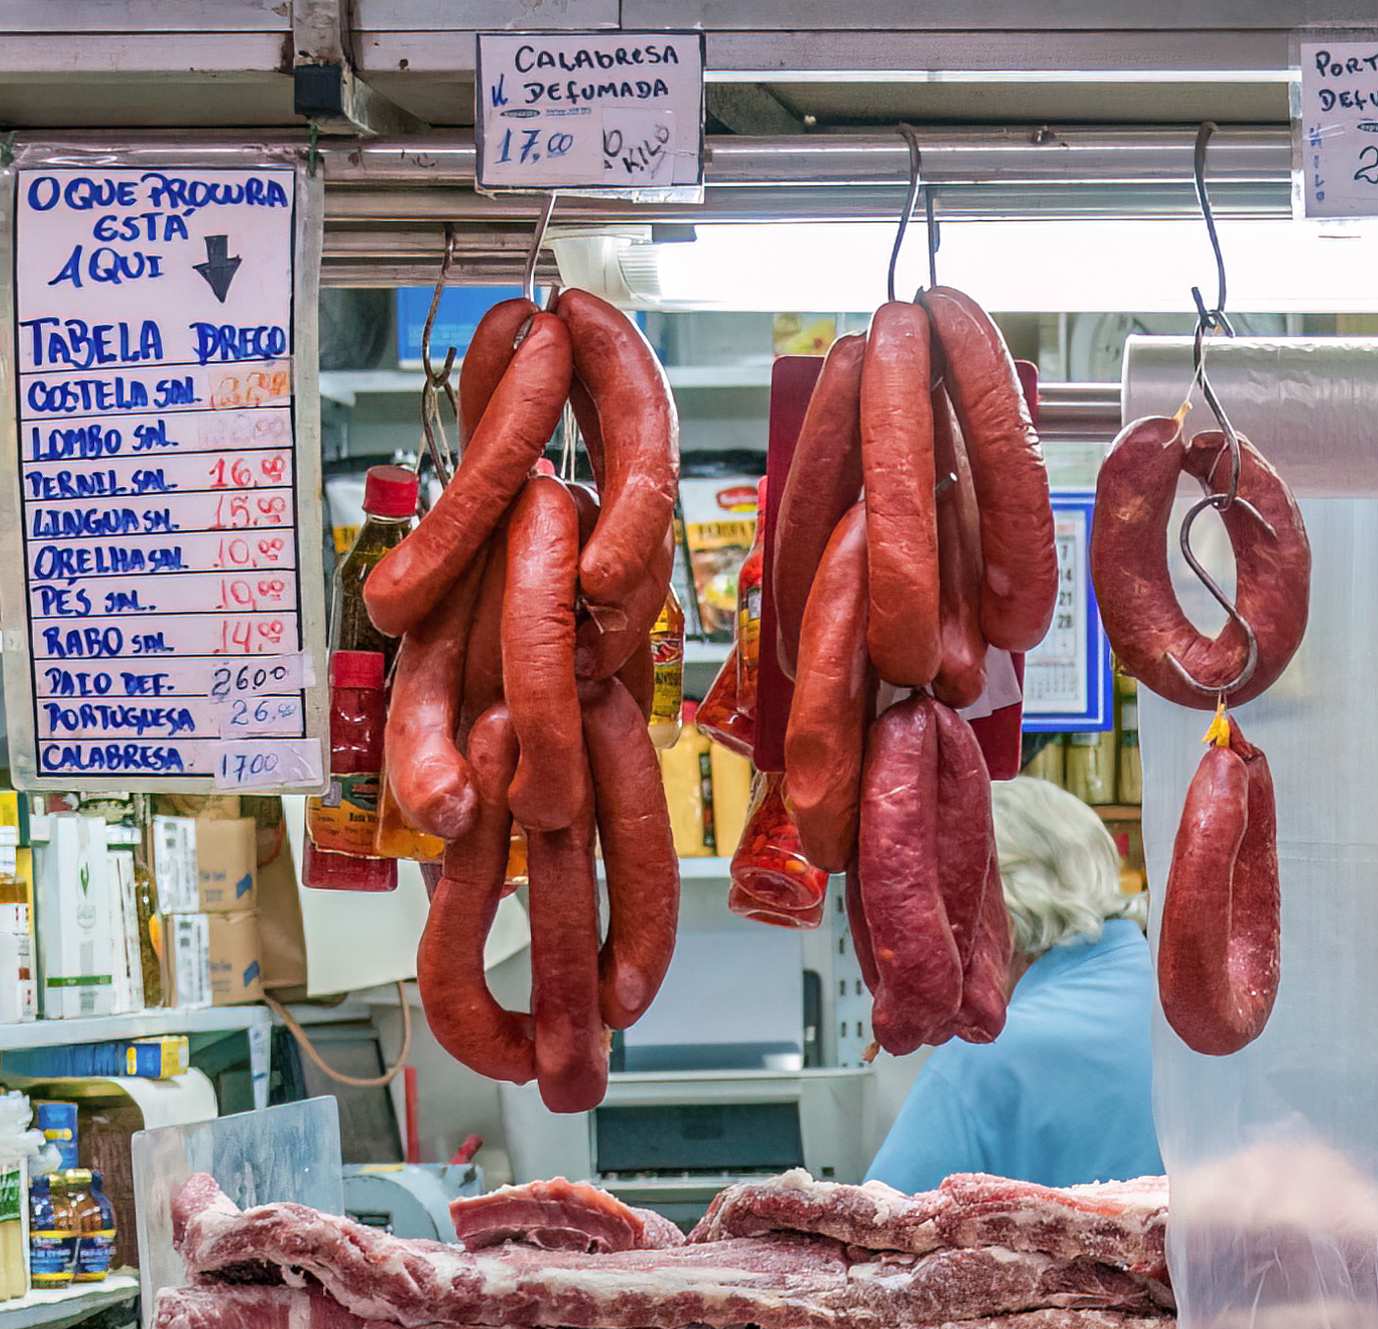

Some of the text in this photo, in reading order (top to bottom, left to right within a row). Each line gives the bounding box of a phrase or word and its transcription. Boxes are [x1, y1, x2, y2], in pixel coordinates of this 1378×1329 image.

[64, 177, 138, 210] QUE
[141, 173, 288, 209] PROCURA
[47, 245, 164, 288] AQUI
[19, 317, 164, 370] TABELA
[27, 377, 148, 413] COSTELA
[33, 425, 121, 460] LOMBO
[25, 469, 126, 500] PERNIL
[33, 508, 139, 537] LINGUA
[34, 545, 145, 579] ORELHA
[43, 626, 123, 657] RABO
[45, 667, 112, 696] PAIO
[43, 702, 196, 736] PORTUGUESA
